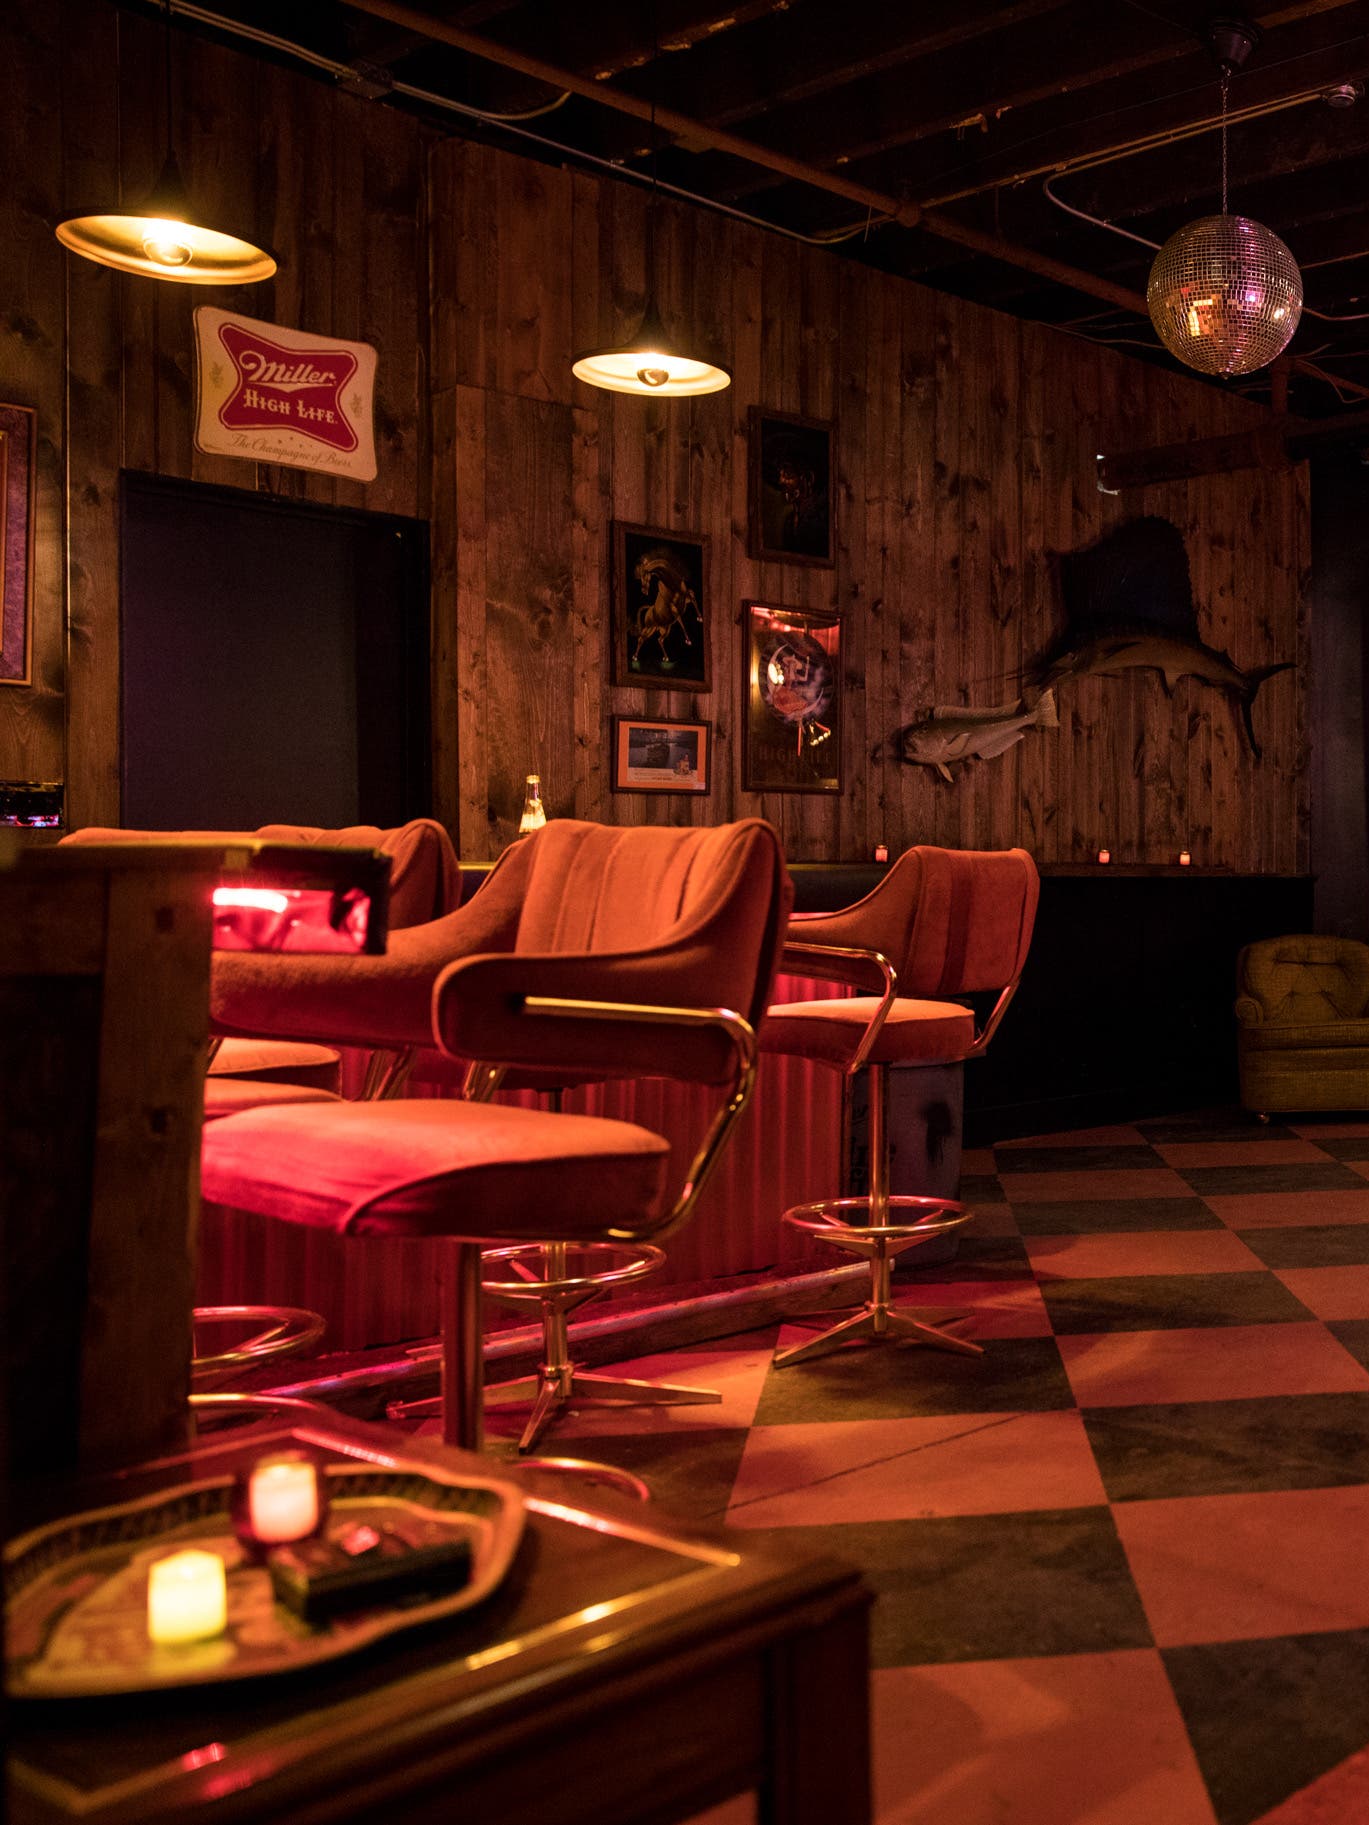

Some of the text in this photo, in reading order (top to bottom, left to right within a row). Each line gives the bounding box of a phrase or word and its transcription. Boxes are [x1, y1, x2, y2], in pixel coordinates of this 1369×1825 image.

[239, 351, 336, 383] Miller
[243, 389, 335, 424] HIGH LIFE
[232, 433, 251, 449] The
[251, 437, 310, 461] Champagne
